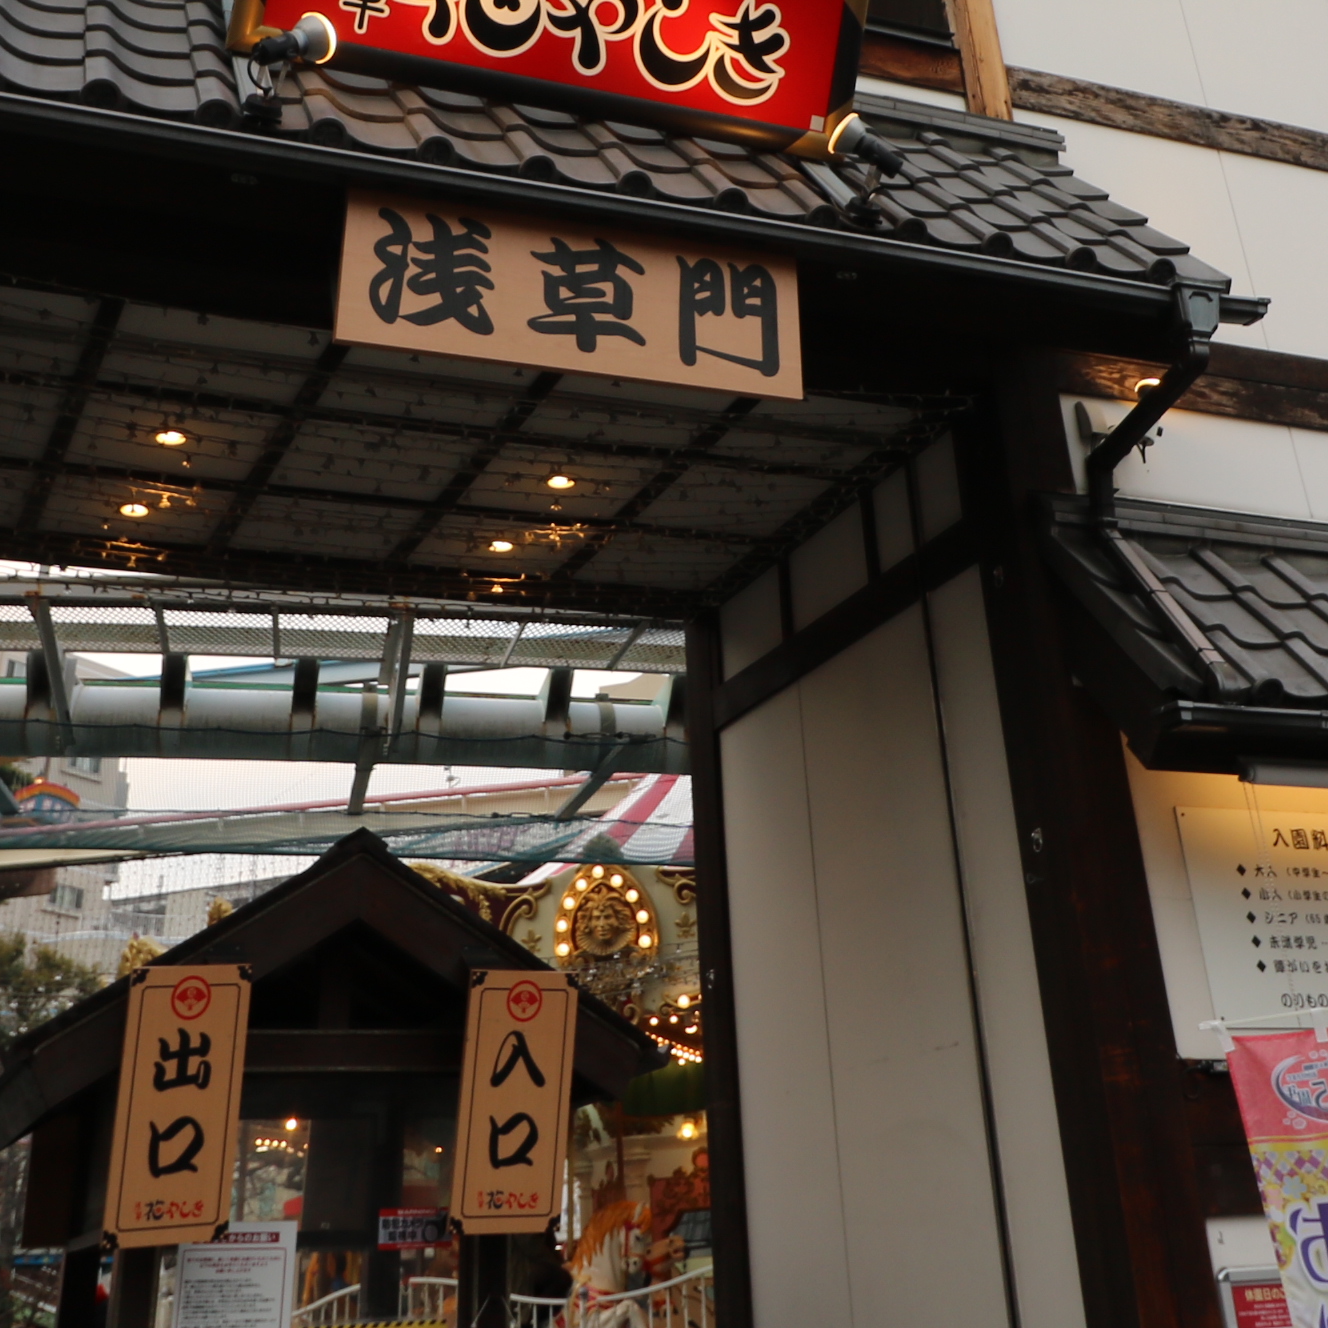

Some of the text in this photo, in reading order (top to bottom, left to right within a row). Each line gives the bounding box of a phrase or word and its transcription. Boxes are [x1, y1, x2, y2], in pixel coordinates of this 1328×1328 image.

[368, 207, 780, 377] 浅草門
[147, 1028, 213, 1179] 出口
[486, 1029, 547, 1169] 入口
